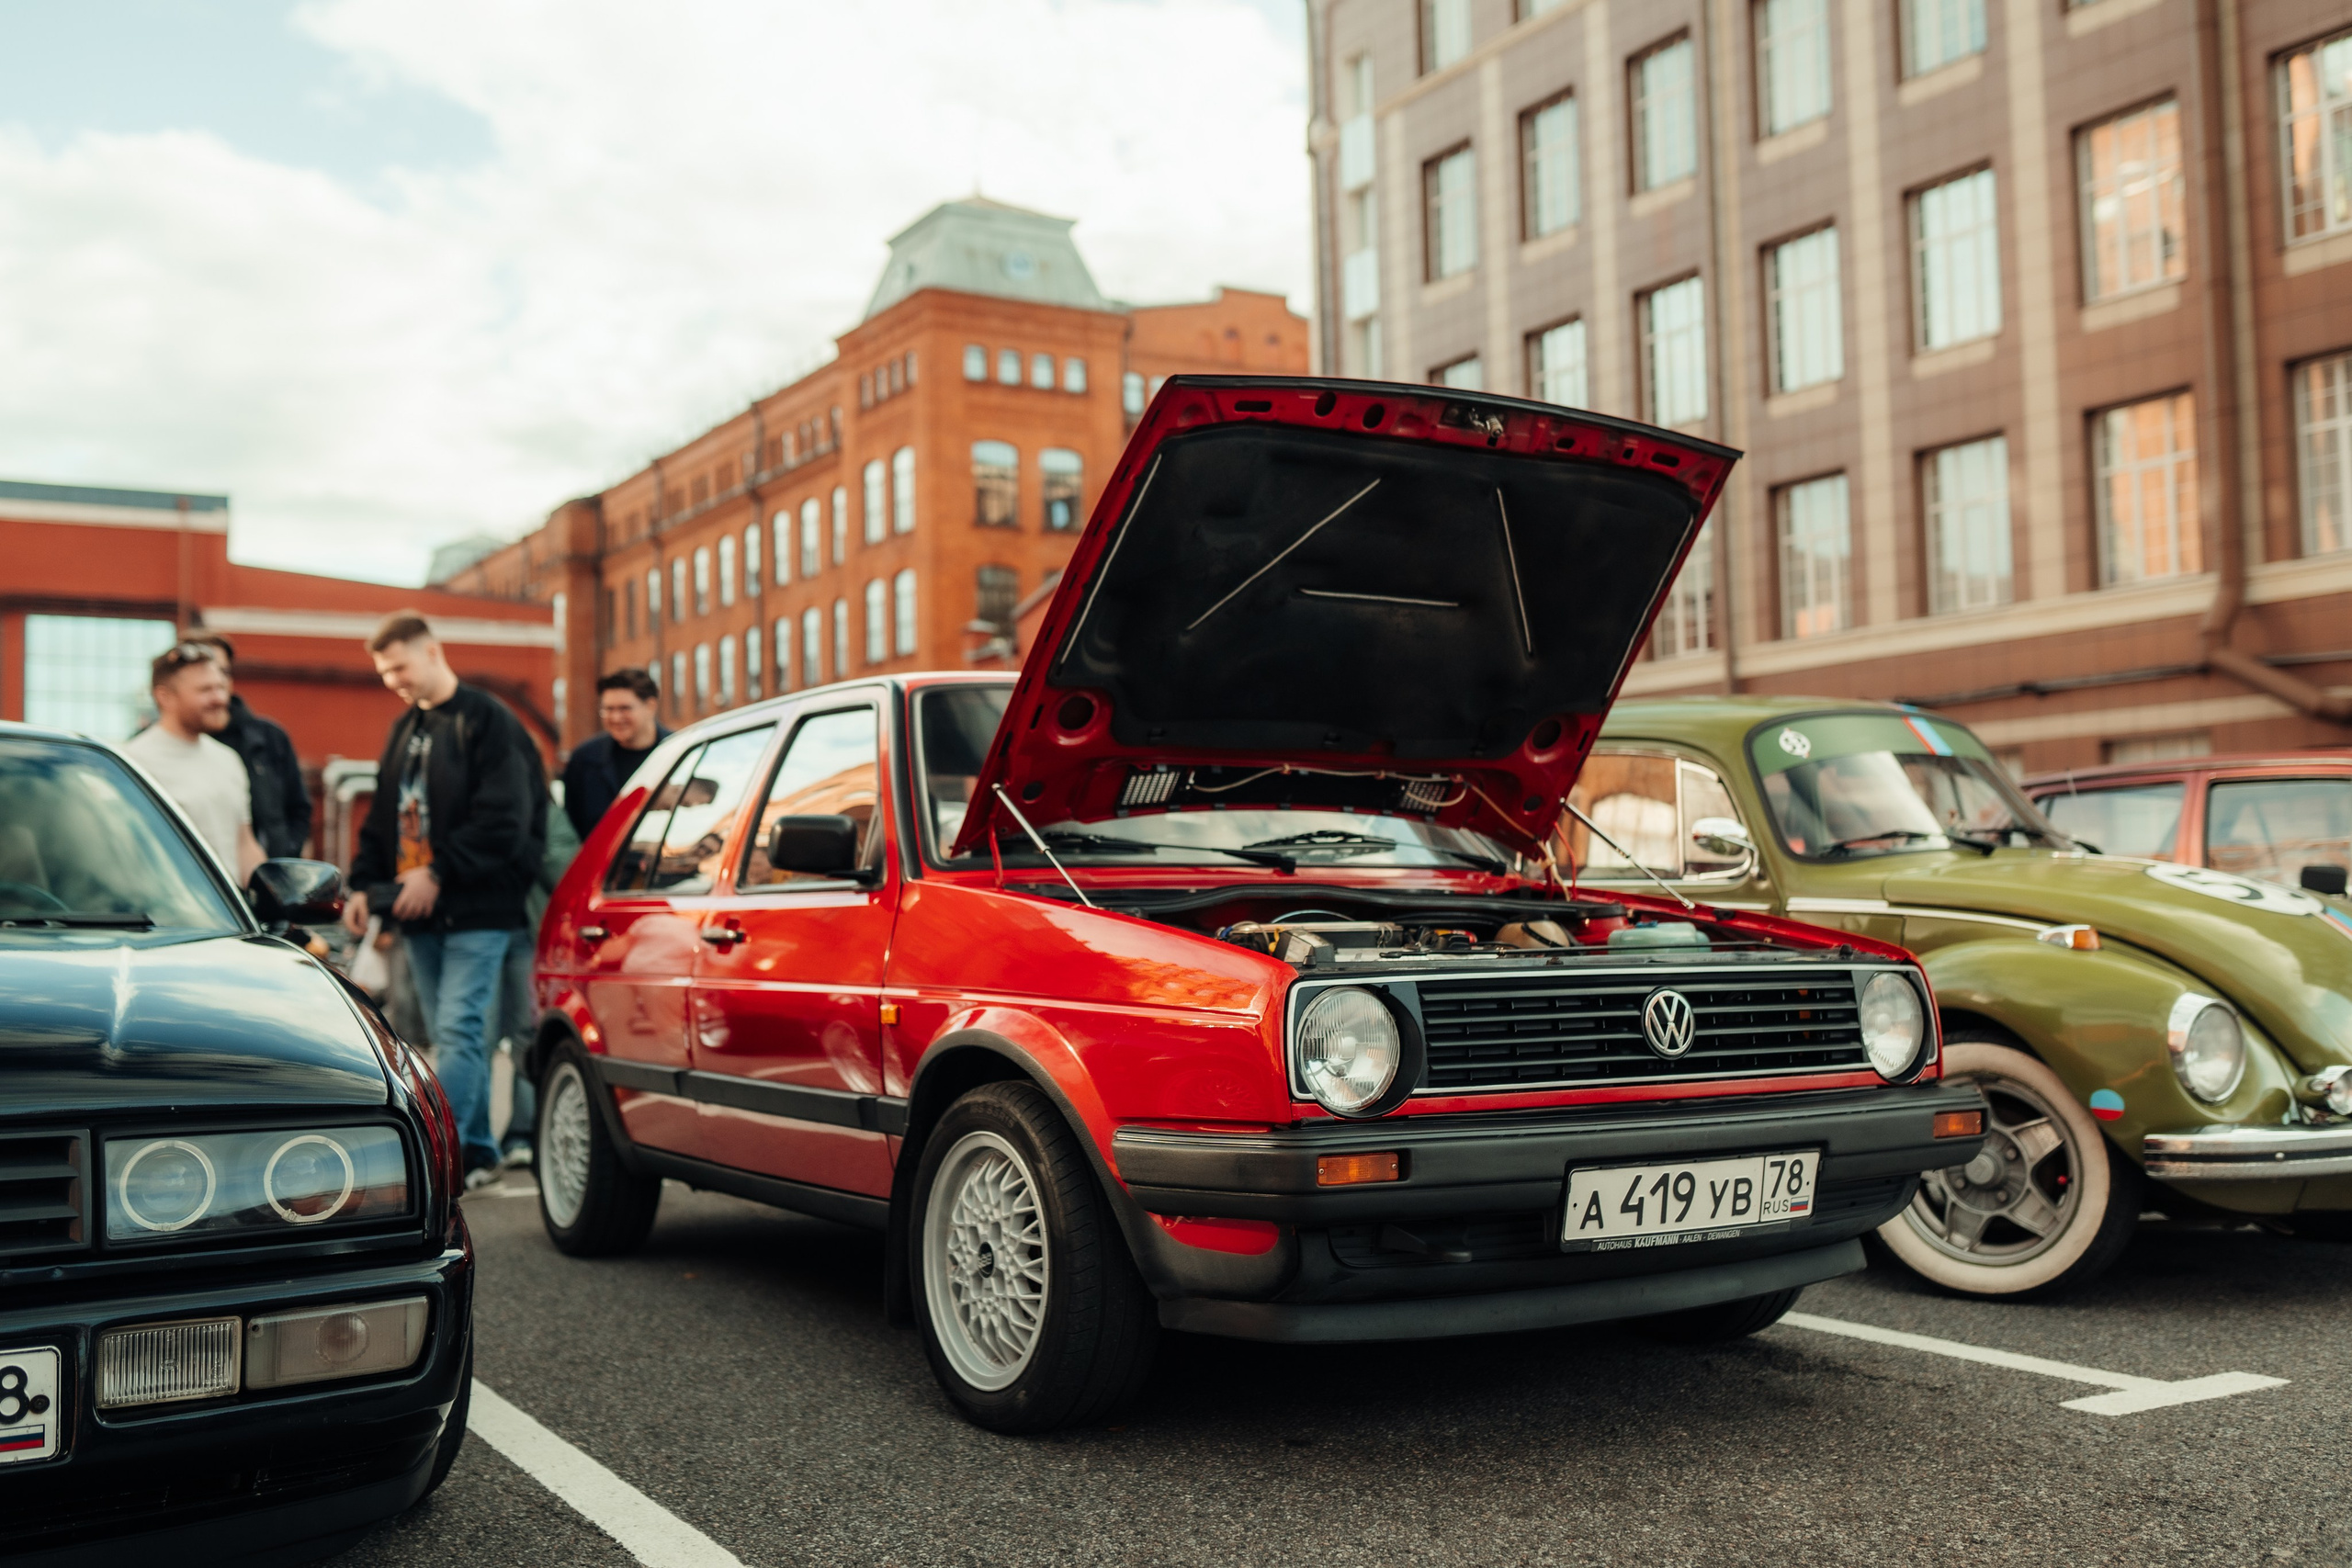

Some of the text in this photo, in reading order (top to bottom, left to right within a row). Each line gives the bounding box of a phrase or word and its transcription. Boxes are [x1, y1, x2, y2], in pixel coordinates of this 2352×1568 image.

[1649, 995, 1691, 1052] VW
[1620, 1171, 1696, 1226] 419
[1770, 1158, 1804, 1198] 78
[1763, 1199, 1789, 1214] RUS
[1597, 1229, 1740, 1250] AUTOHAUS KAUFMANN AALEN DEWANGEN
